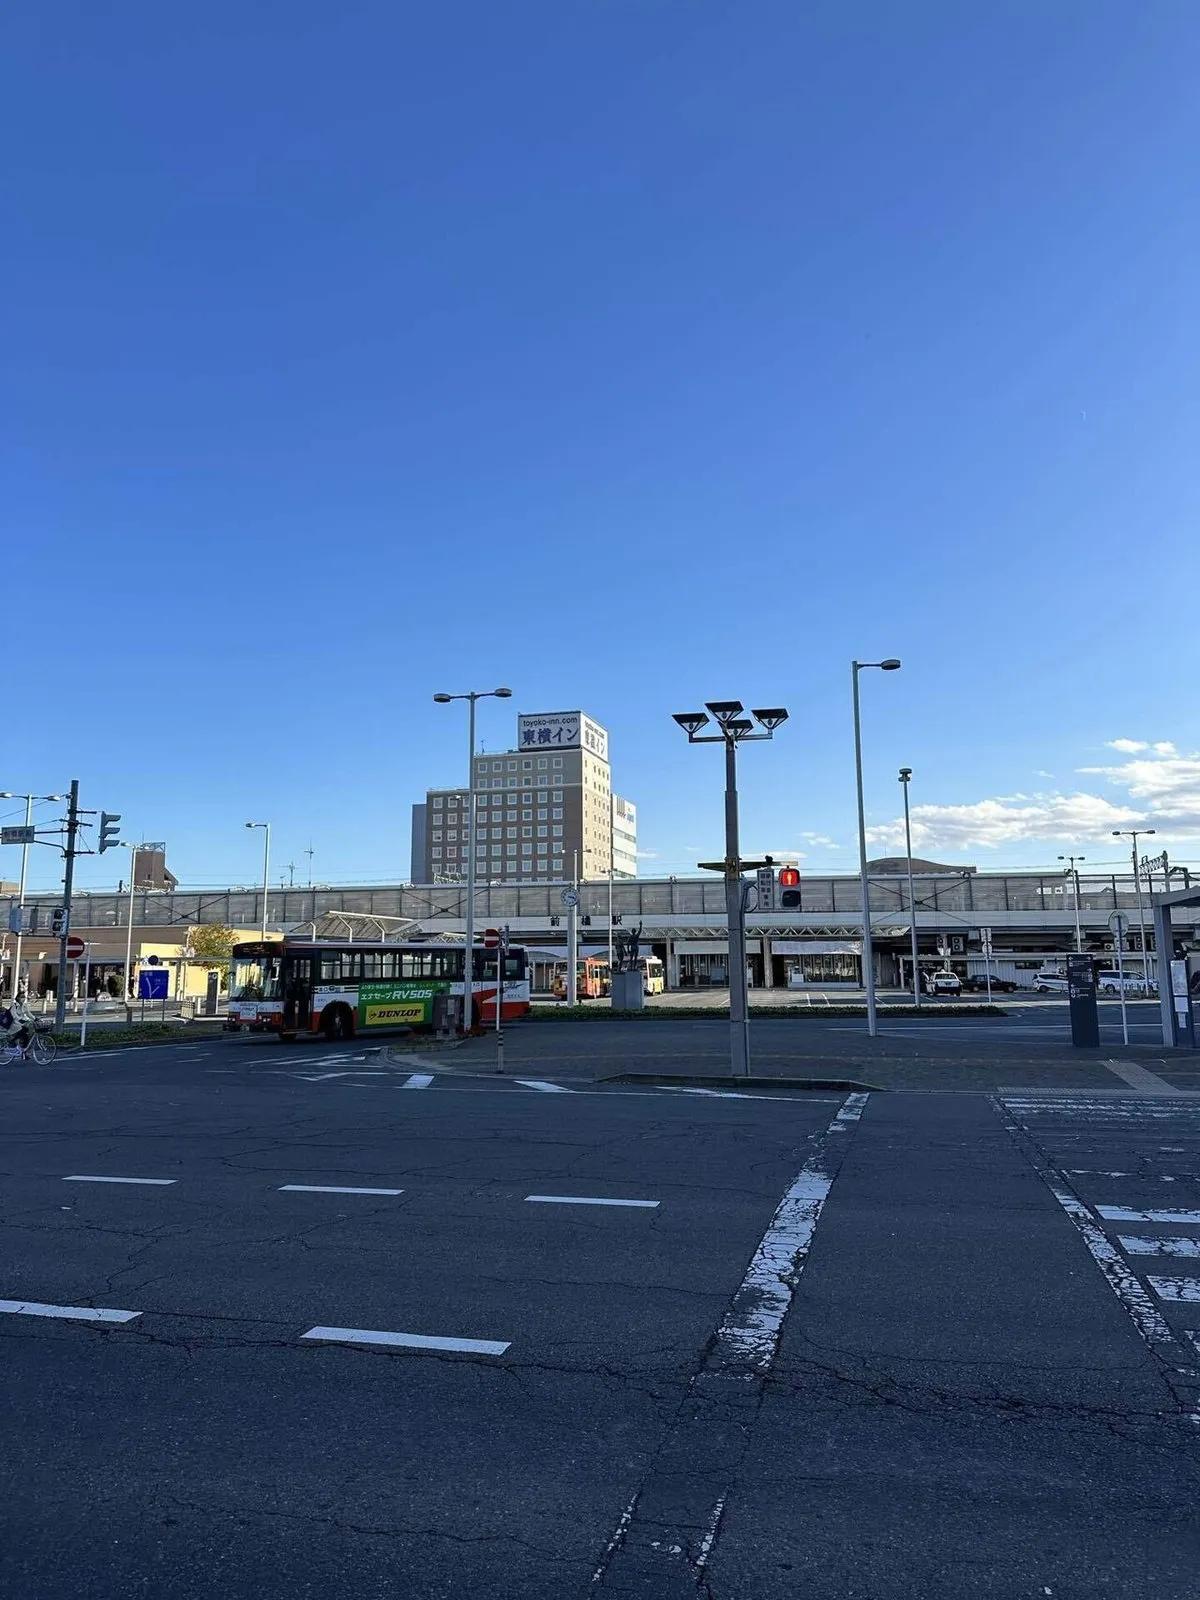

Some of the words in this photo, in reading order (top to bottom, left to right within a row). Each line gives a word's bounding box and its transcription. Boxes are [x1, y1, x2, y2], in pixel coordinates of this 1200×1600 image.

[523, 717, 578, 728] toyoko-inn.com
[522, 727, 579, 746] 東横イン
[392, 989, 433, 1000] RV505
[376, 1008, 422, 1019] DUNLOP
